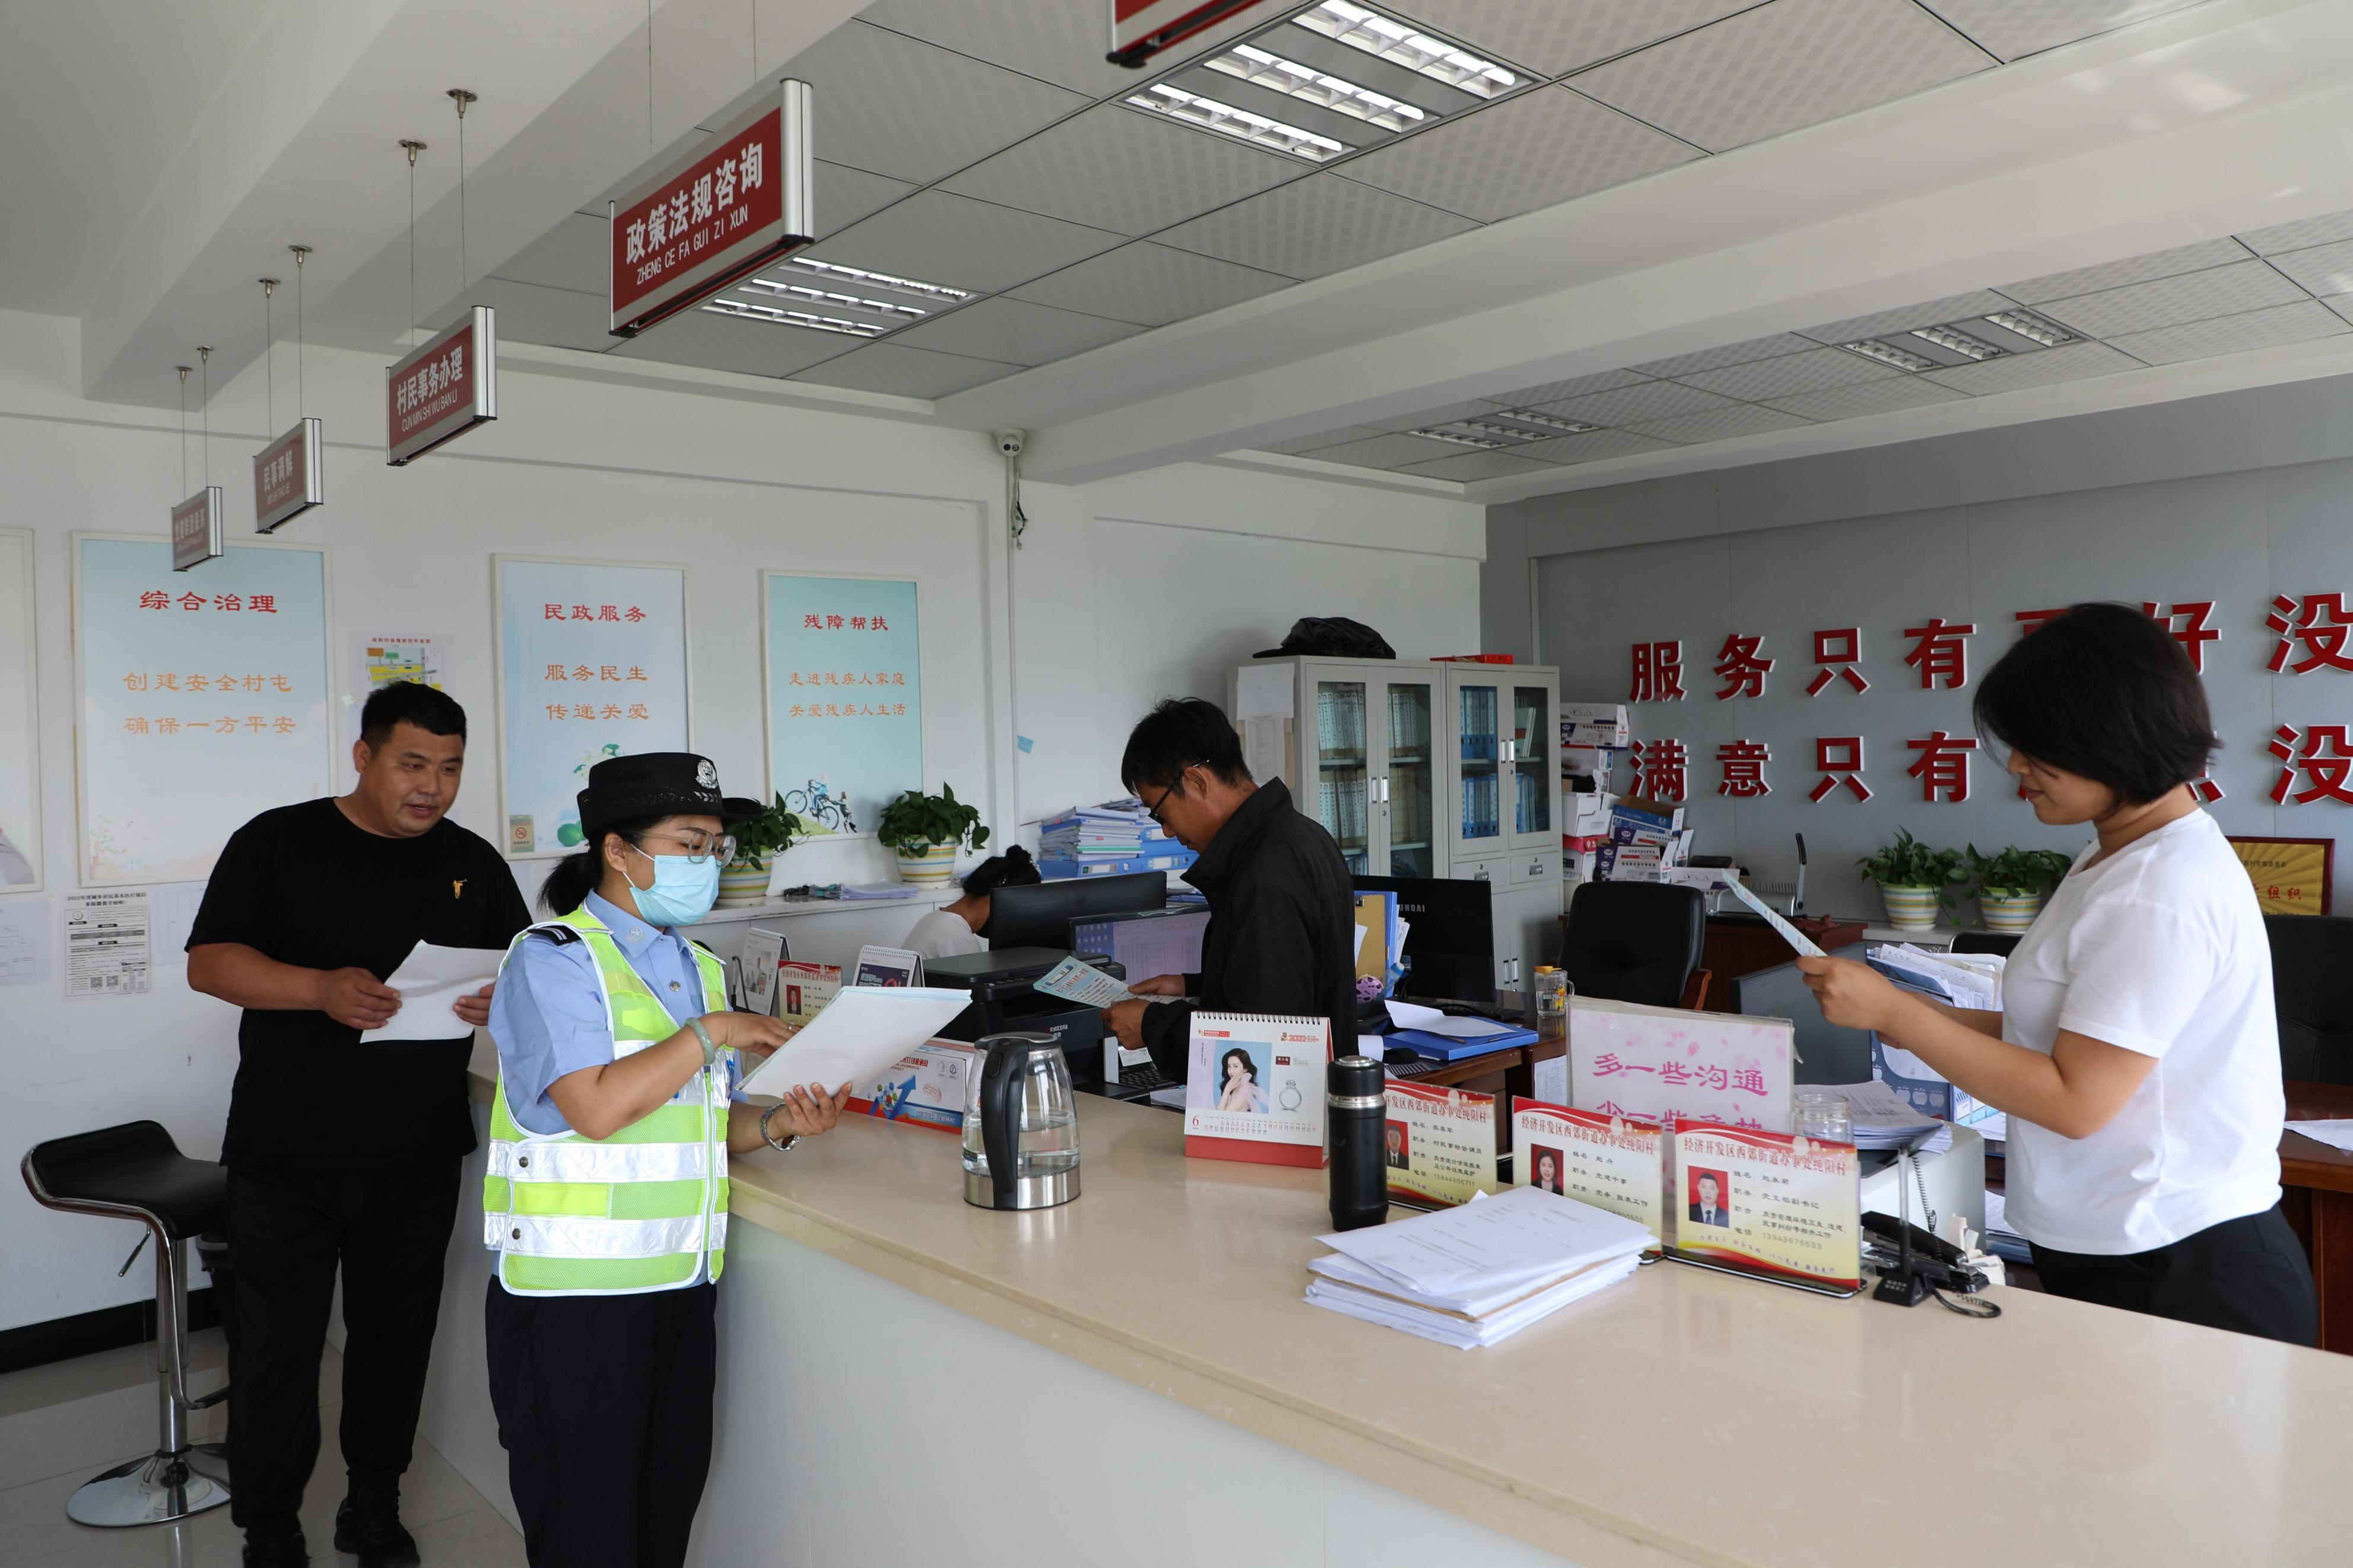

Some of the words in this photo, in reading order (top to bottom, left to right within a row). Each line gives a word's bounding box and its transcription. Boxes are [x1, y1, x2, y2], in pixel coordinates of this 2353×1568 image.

[626, 142, 763, 265] 政策法规咨询
[637, 257, 661, 285] ZHENG
[665, 248, 675, 268] CE
[679, 239, 690, 260] FA
[693, 227, 709, 252] GUI
[714, 218, 724, 240] ZI
[730, 203, 748, 231] XUN
[397, 345, 463, 416] 村民事务办理
[412, 409, 423, 427] MIN
[422, 404, 431, 420] SHI
[431, 398, 440, 414] WU
[441, 390, 452, 410] BAN
[452, 387, 458, 403] LI
[264, 449, 293, 492] 民事调解
[139, 590, 278, 613] 综合治理
[544, 603, 647, 622] 民政服务
[804, 614, 889, 631] 残障帮扶
[1630, 592, 2353, 704] 服务只有好没
[122, 672, 293, 692] 创建安全村屯
[544, 664, 648, 682] 服务民生
[789, 672, 906, 686] 走进残疾人家庭
[545, 703, 649, 721] 传递关爱
[789, 702, 906, 717] 关爱残疾人生活
[124, 715, 296, 734] 确保一方平安
[1630, 723, 2353, 806] 满意只有没
[1050, 1024, 1068, 1032] KYOCERA
[1592, 1052, 1768, 1096] 多一些沟通
[1192, 1115, 1199, 1127] 6
[1522, 1115, 1655, 1156] 经济开发区西郊街道办事处纯阳村
[1684, 1137, 1847, 1176] 经济开发区西郊街道办事处纯阳村
[1762, 1232, 1822, 1250] 13943676533
